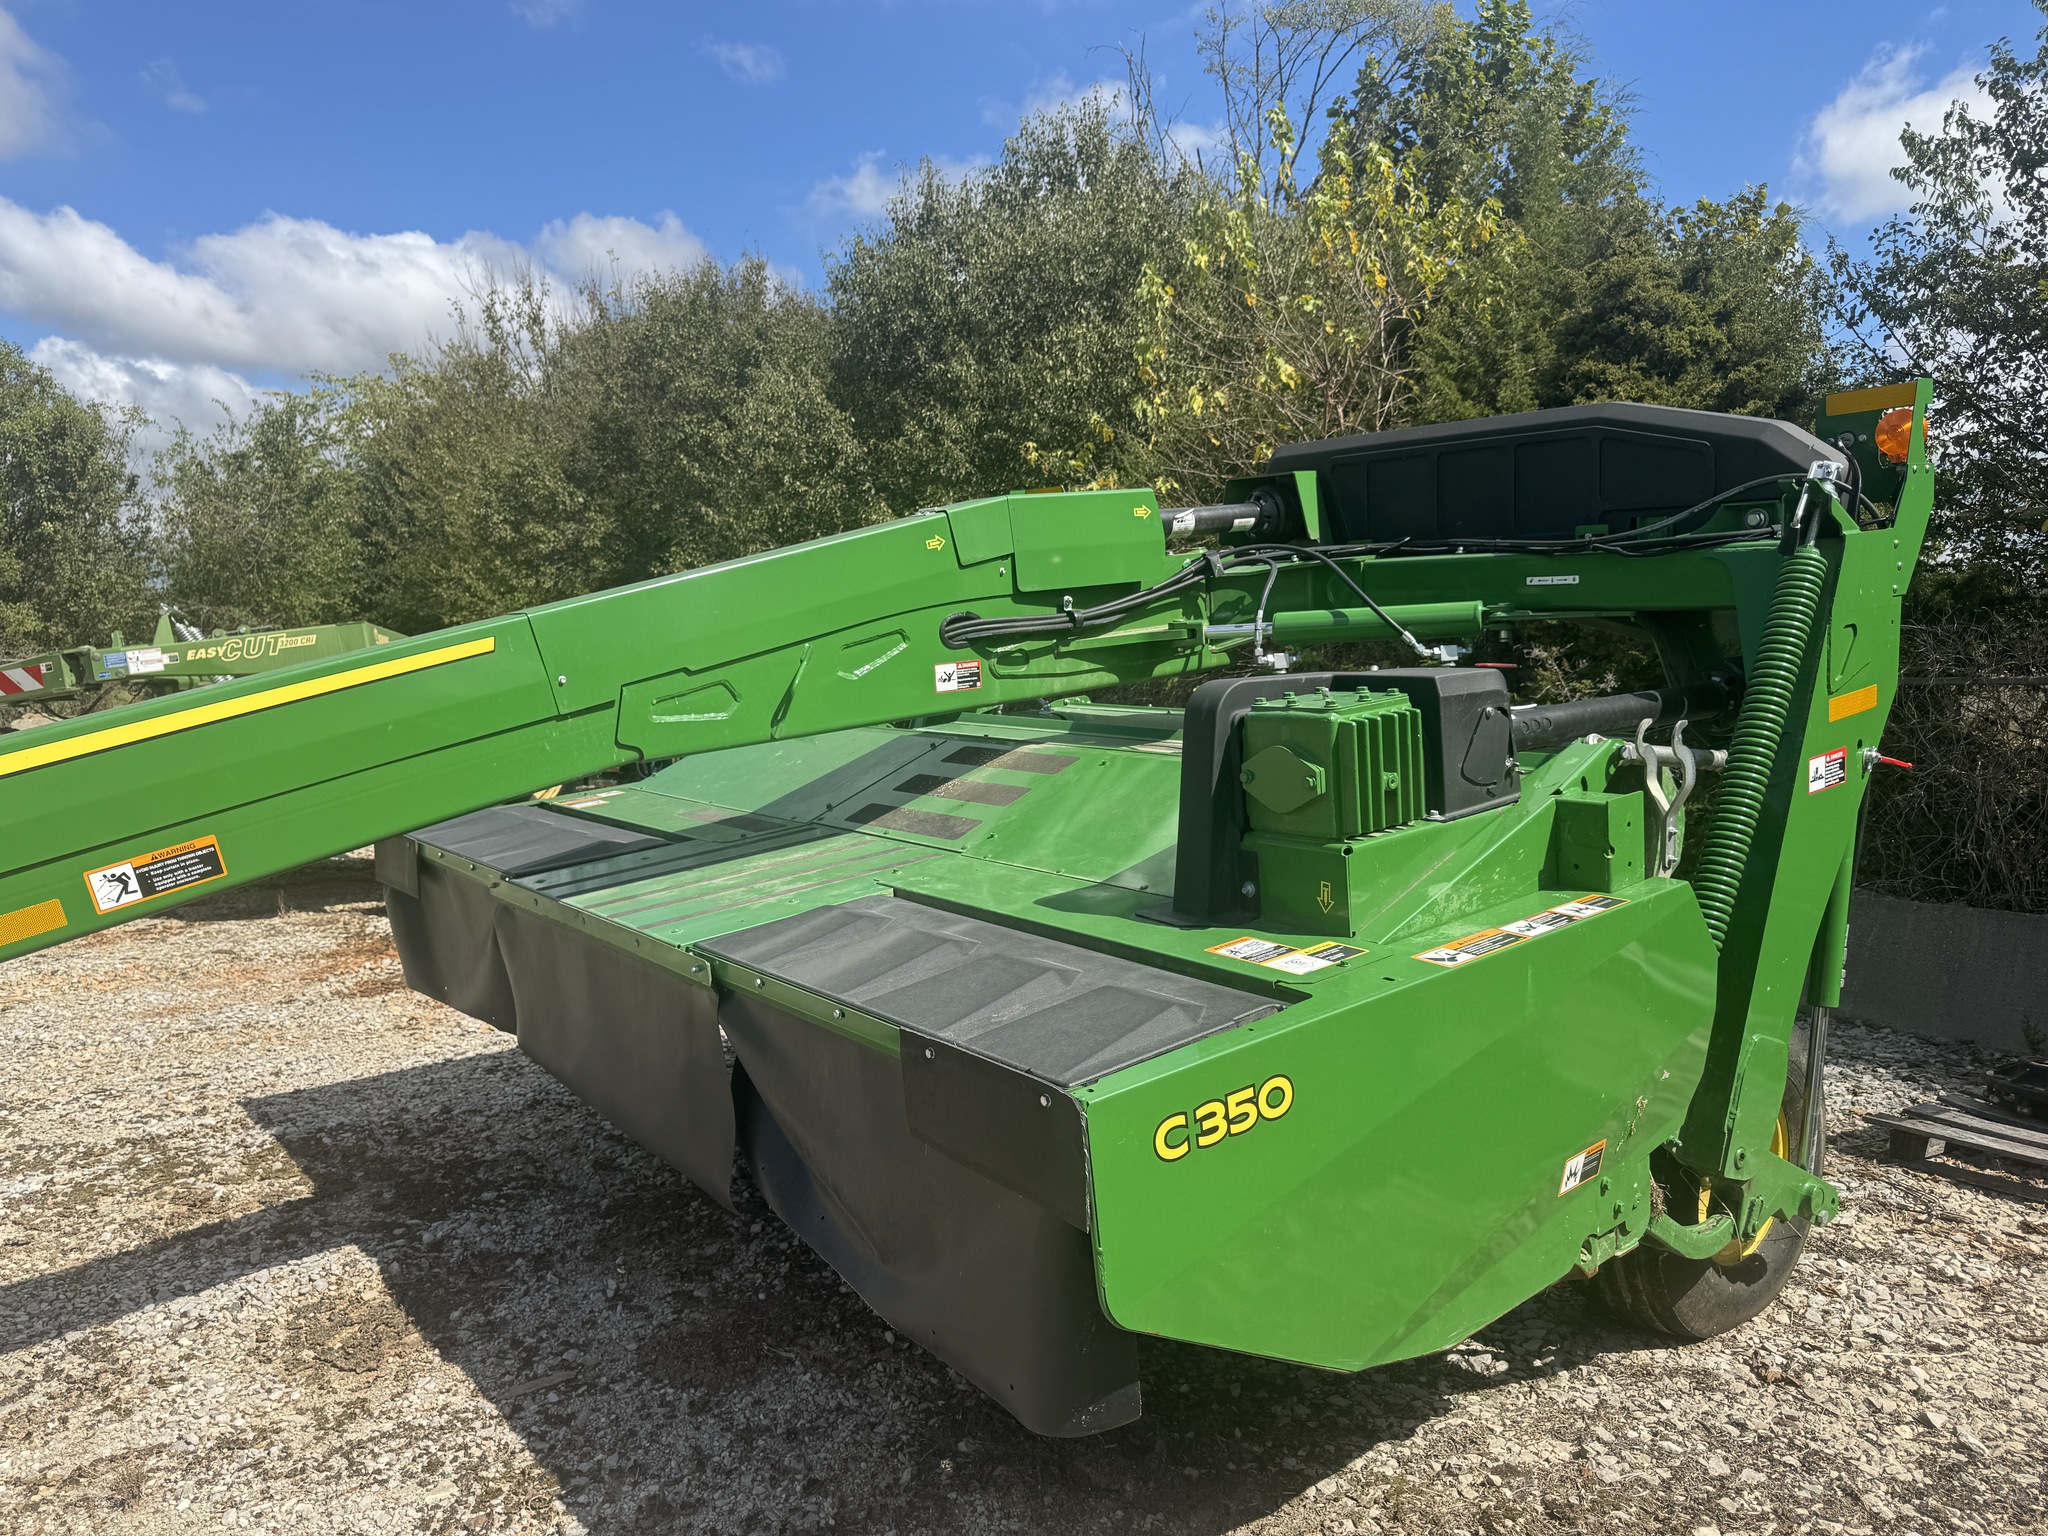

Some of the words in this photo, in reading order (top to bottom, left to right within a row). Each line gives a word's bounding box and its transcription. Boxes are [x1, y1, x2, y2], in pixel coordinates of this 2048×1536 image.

[157, 842, 196, 859] WARNING
[165, 858, 177, 866] FROM
[196, 847, 215, 856] OBJECTS
[163, 864, 180, 872] curtain
[191, 866, 212, 875] complete
[1153, 1111, 1191, 1163] C
[1193, 1074, 1294, 1149] 350
